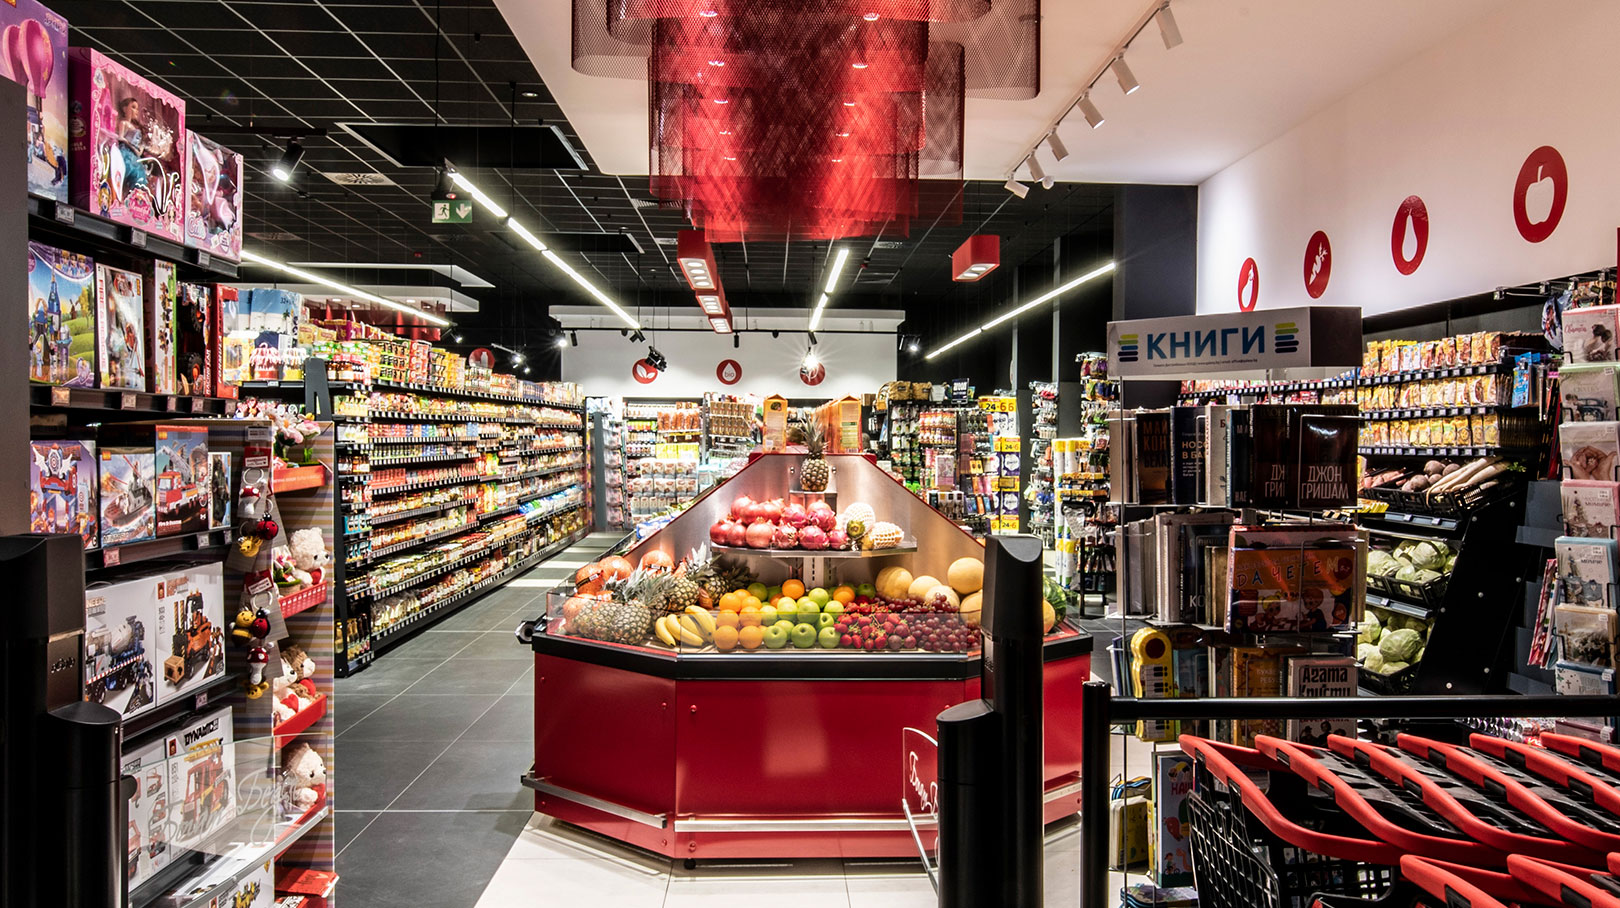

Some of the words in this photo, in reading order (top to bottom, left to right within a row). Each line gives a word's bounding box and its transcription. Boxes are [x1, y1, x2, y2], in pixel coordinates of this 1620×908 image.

[1147, 325, 1265, 360] КНИГИ
[1308, 466, 1342, 482] ДЖОН
[1265, 481, 1285, 498] ГРИ
[1301, 483, 1349, 499] ГРИШАМ
[1303, 664, 1348, 683] Агата
